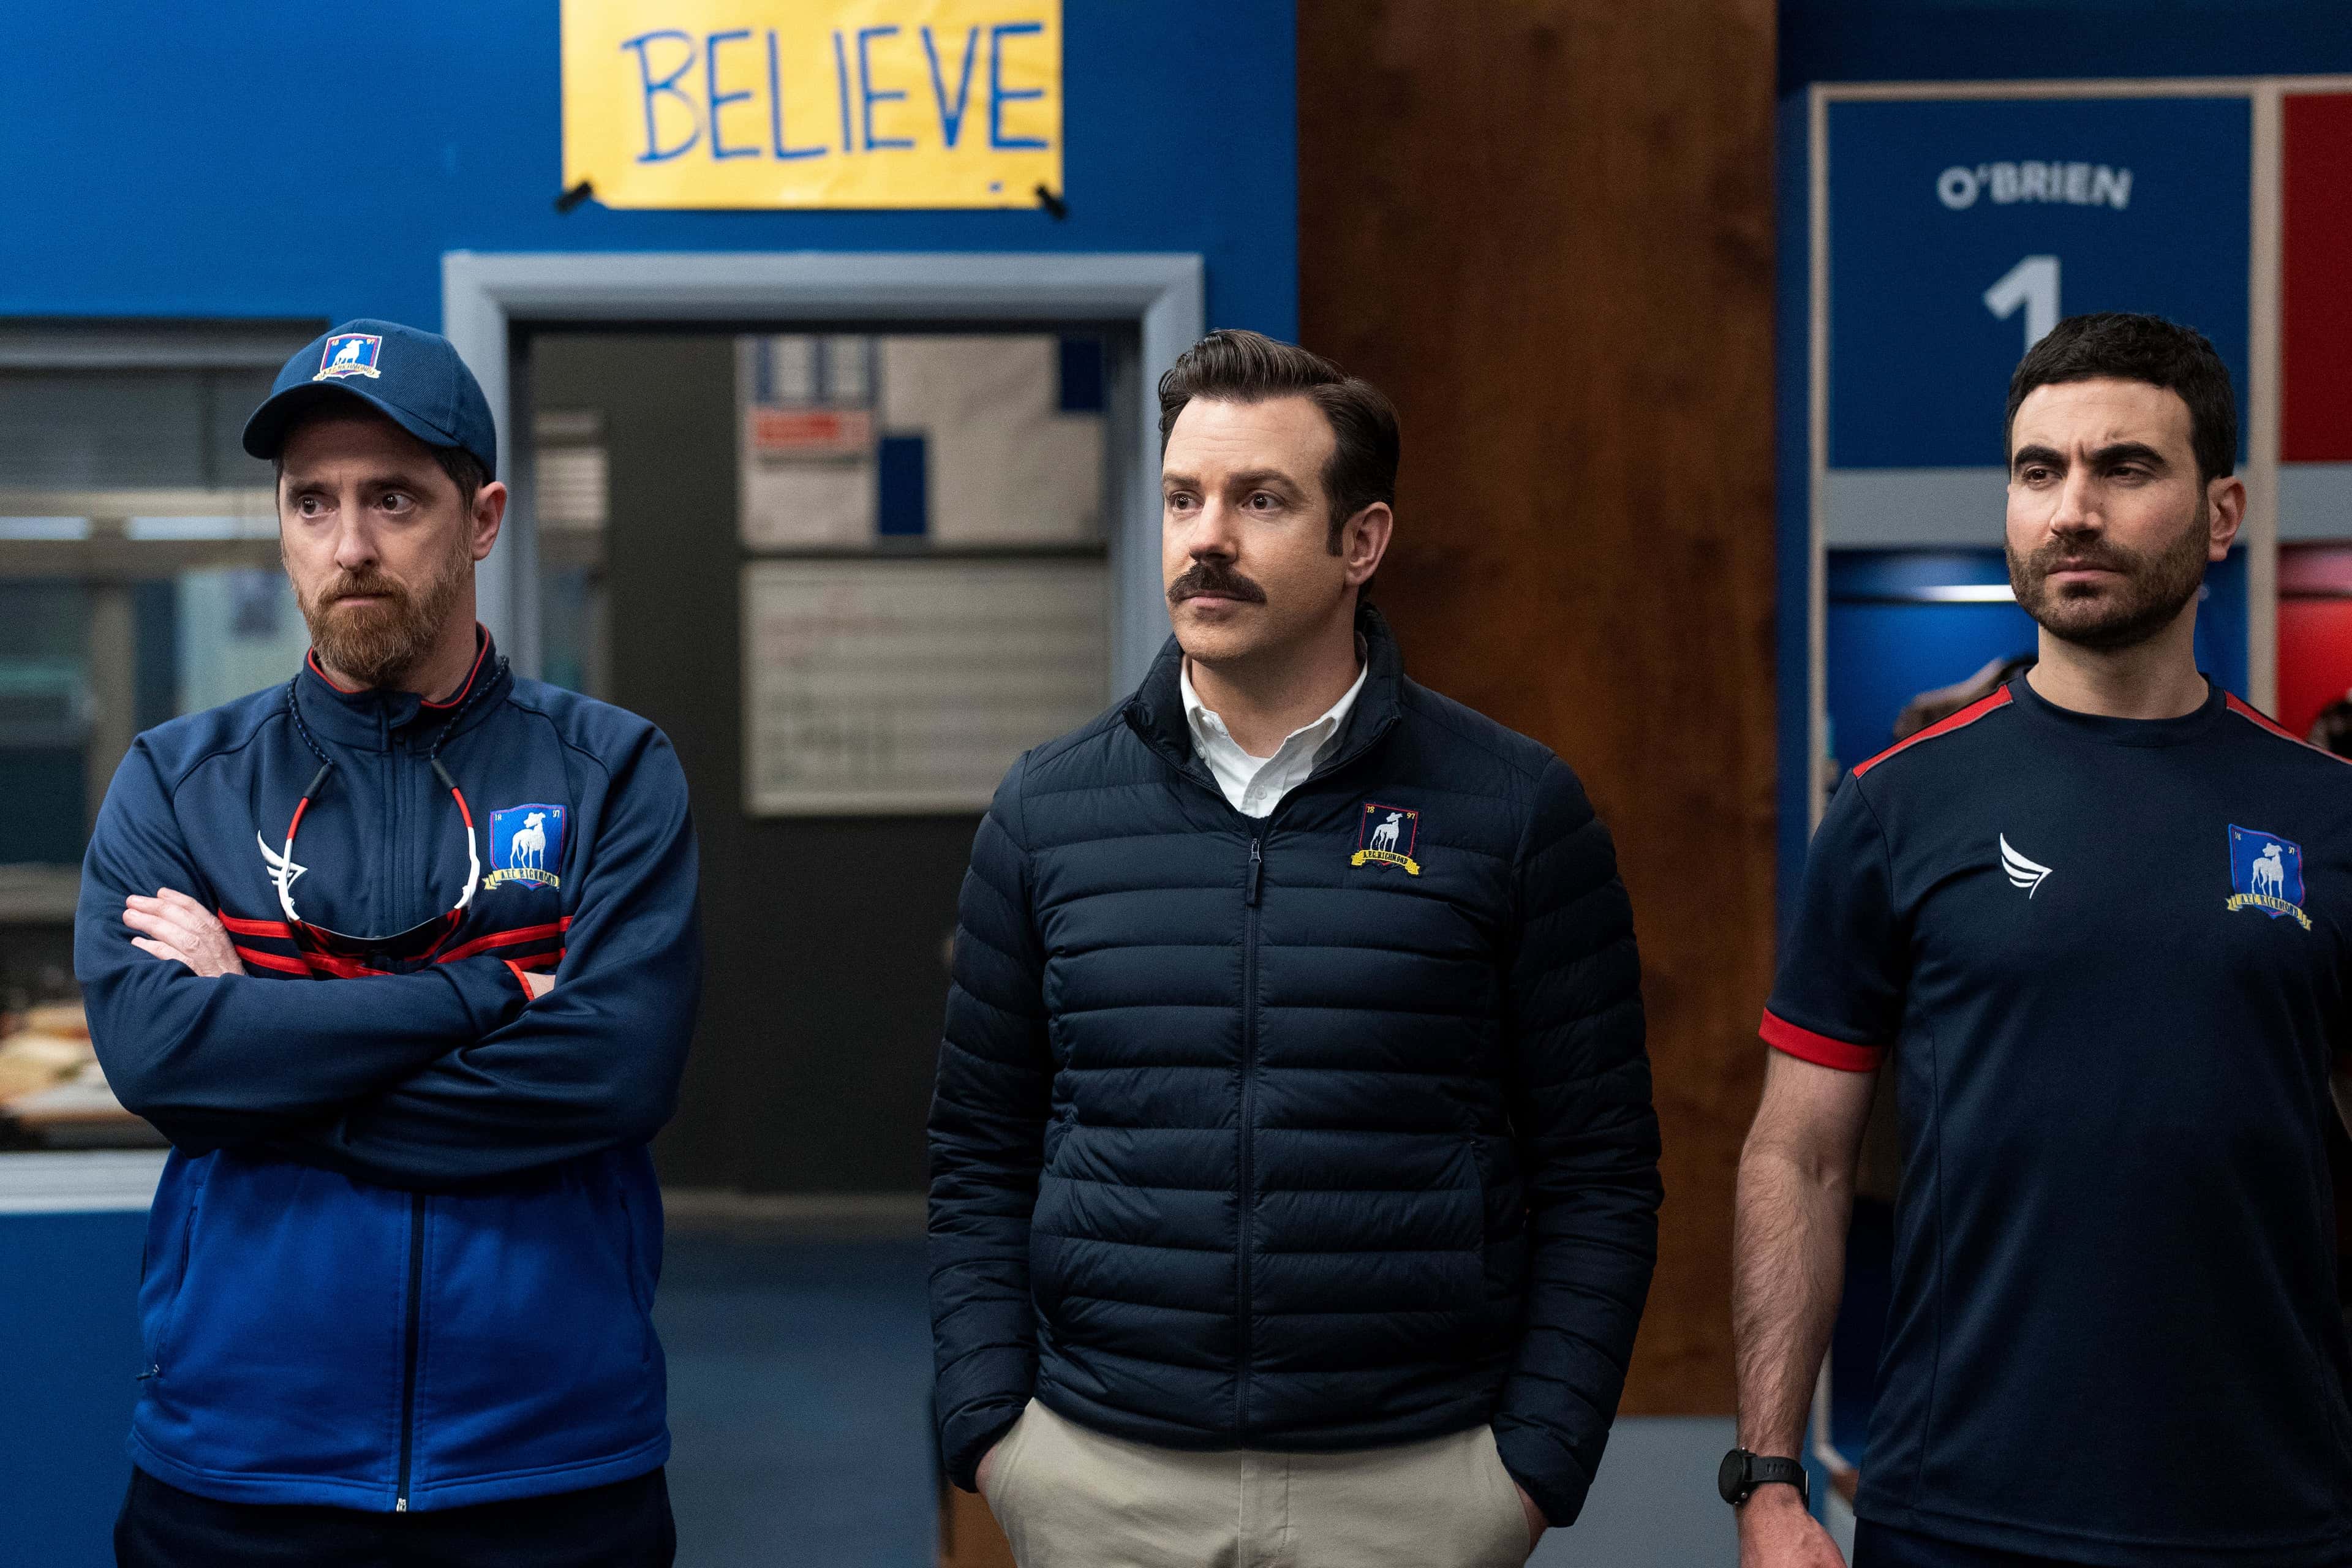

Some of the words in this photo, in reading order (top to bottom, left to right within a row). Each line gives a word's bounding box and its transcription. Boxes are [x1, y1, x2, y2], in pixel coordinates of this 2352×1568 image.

[620, 20, 1049, 164] BELIEVE
[1937, 161, 2133, 209] O'BRIEN
[1983, 255, 2062, 355] 1
[552, 810, 560, 818] 97
[2234, 831, 2241, 841] 18
